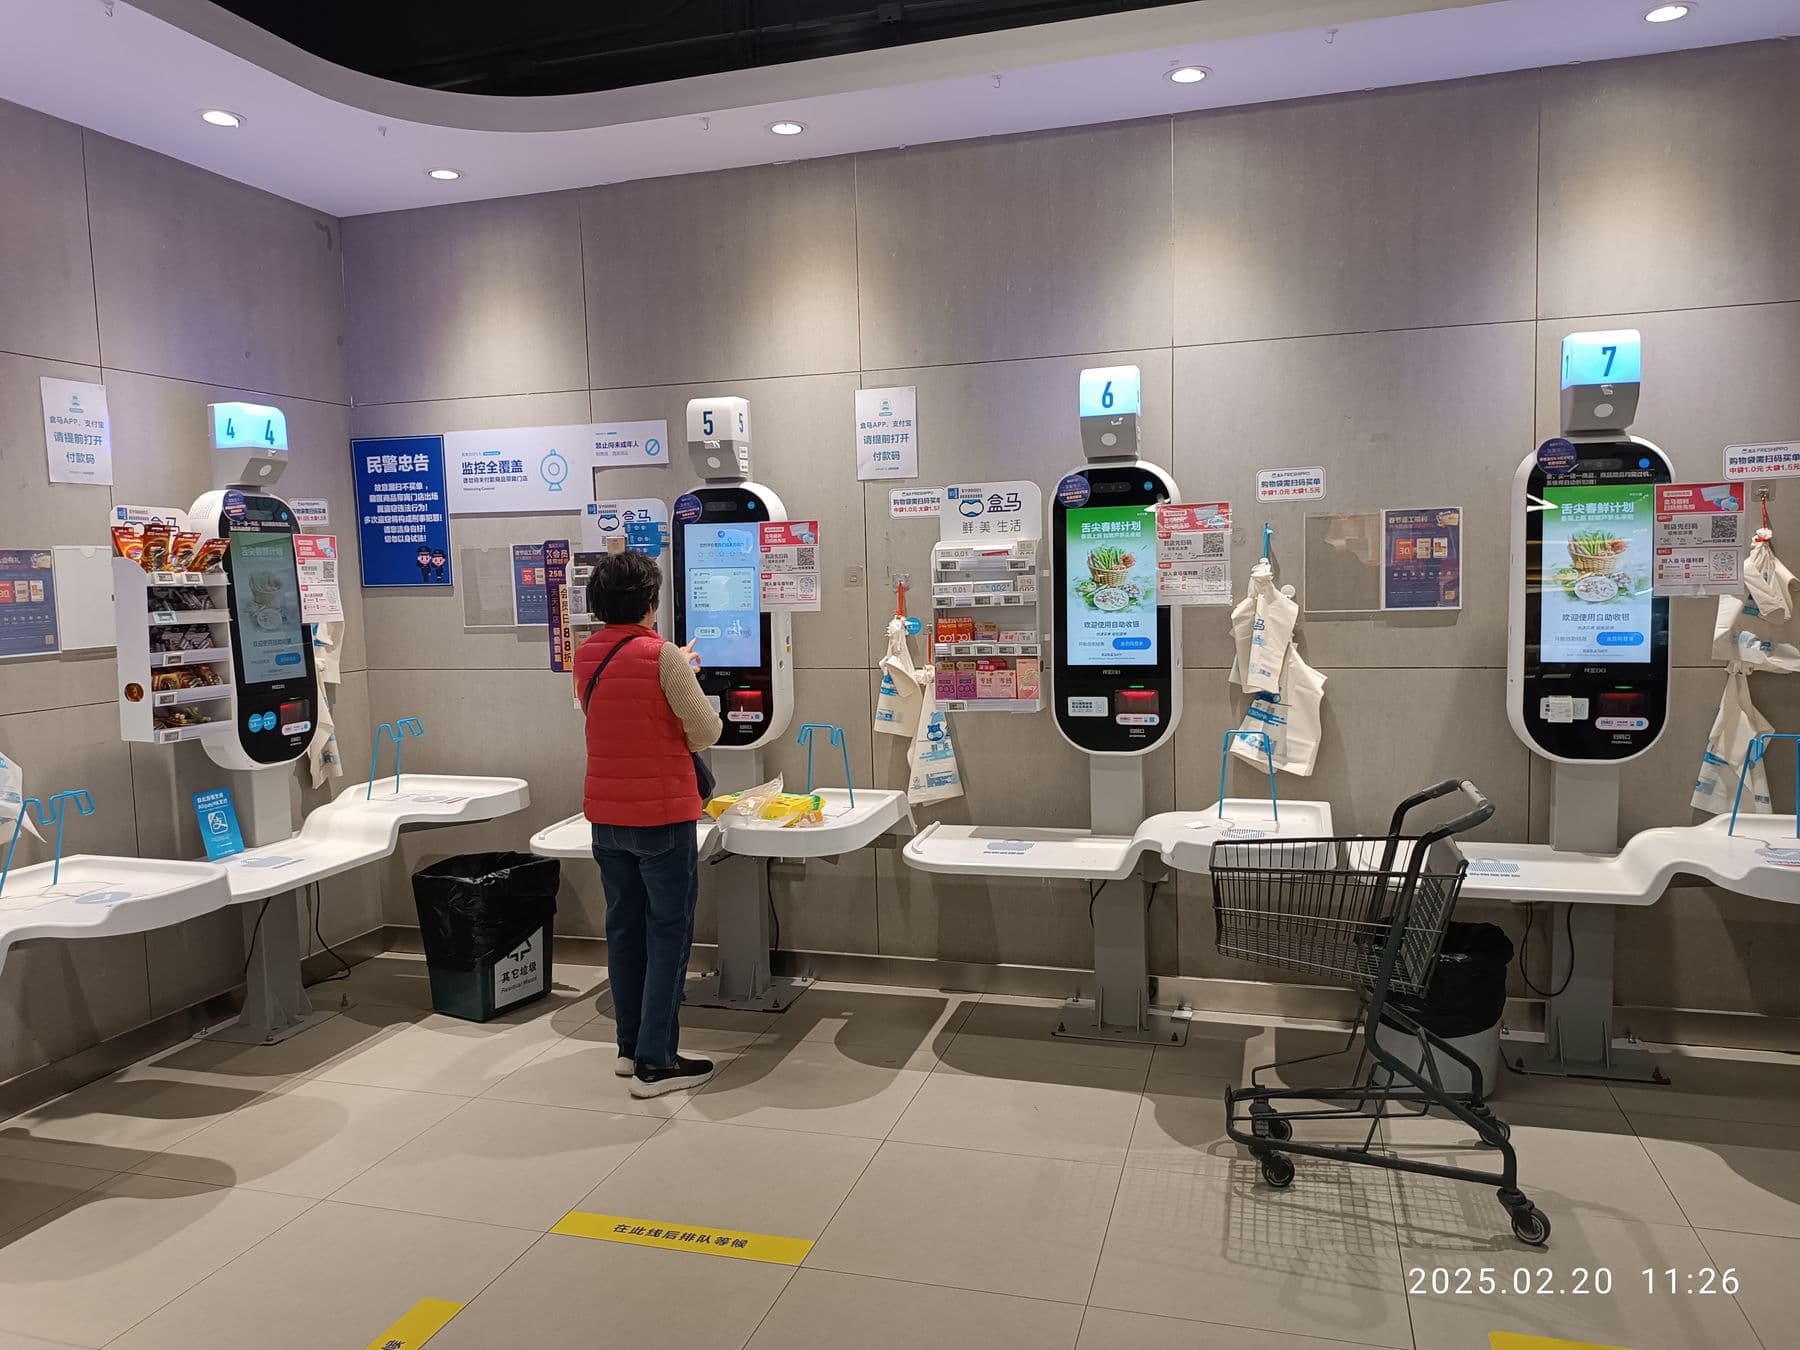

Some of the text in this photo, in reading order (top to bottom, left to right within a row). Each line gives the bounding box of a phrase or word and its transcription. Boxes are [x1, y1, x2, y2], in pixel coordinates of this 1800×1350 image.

[1602, 346, 1616, 377] 7
[1101, 381, 1114, 409] 6
[226, 417, 236, 439] 4
[703, 410, 714, 436] 5
[738, 412, 744, 433] 5
[53, 431, 103, 446] 请提前打开
[265, 419, 275, 446] 4
[863, 433, 910, 445] 请提前打开
[65, 452, 96, 465] 付款码
[366, 453, 430, 474] 民警忠告
[873, 450, 901, 462] 付款码
[461, 459, 524, 475] 监控全覆盖
[986, 492, 1022, 513] 盒马
[1561, 501, 1635, 515] 舌尖春鲜计划
[1081, 520, 1142, 533] 舌尖春鲜计划
[1084, 620, 1140, 628] 欢迎使用自助收银
[1562, 612, 1630, 621] 欢迎使用自助收银
[612, 1223, 749, 1249] 在此线后排队等候
